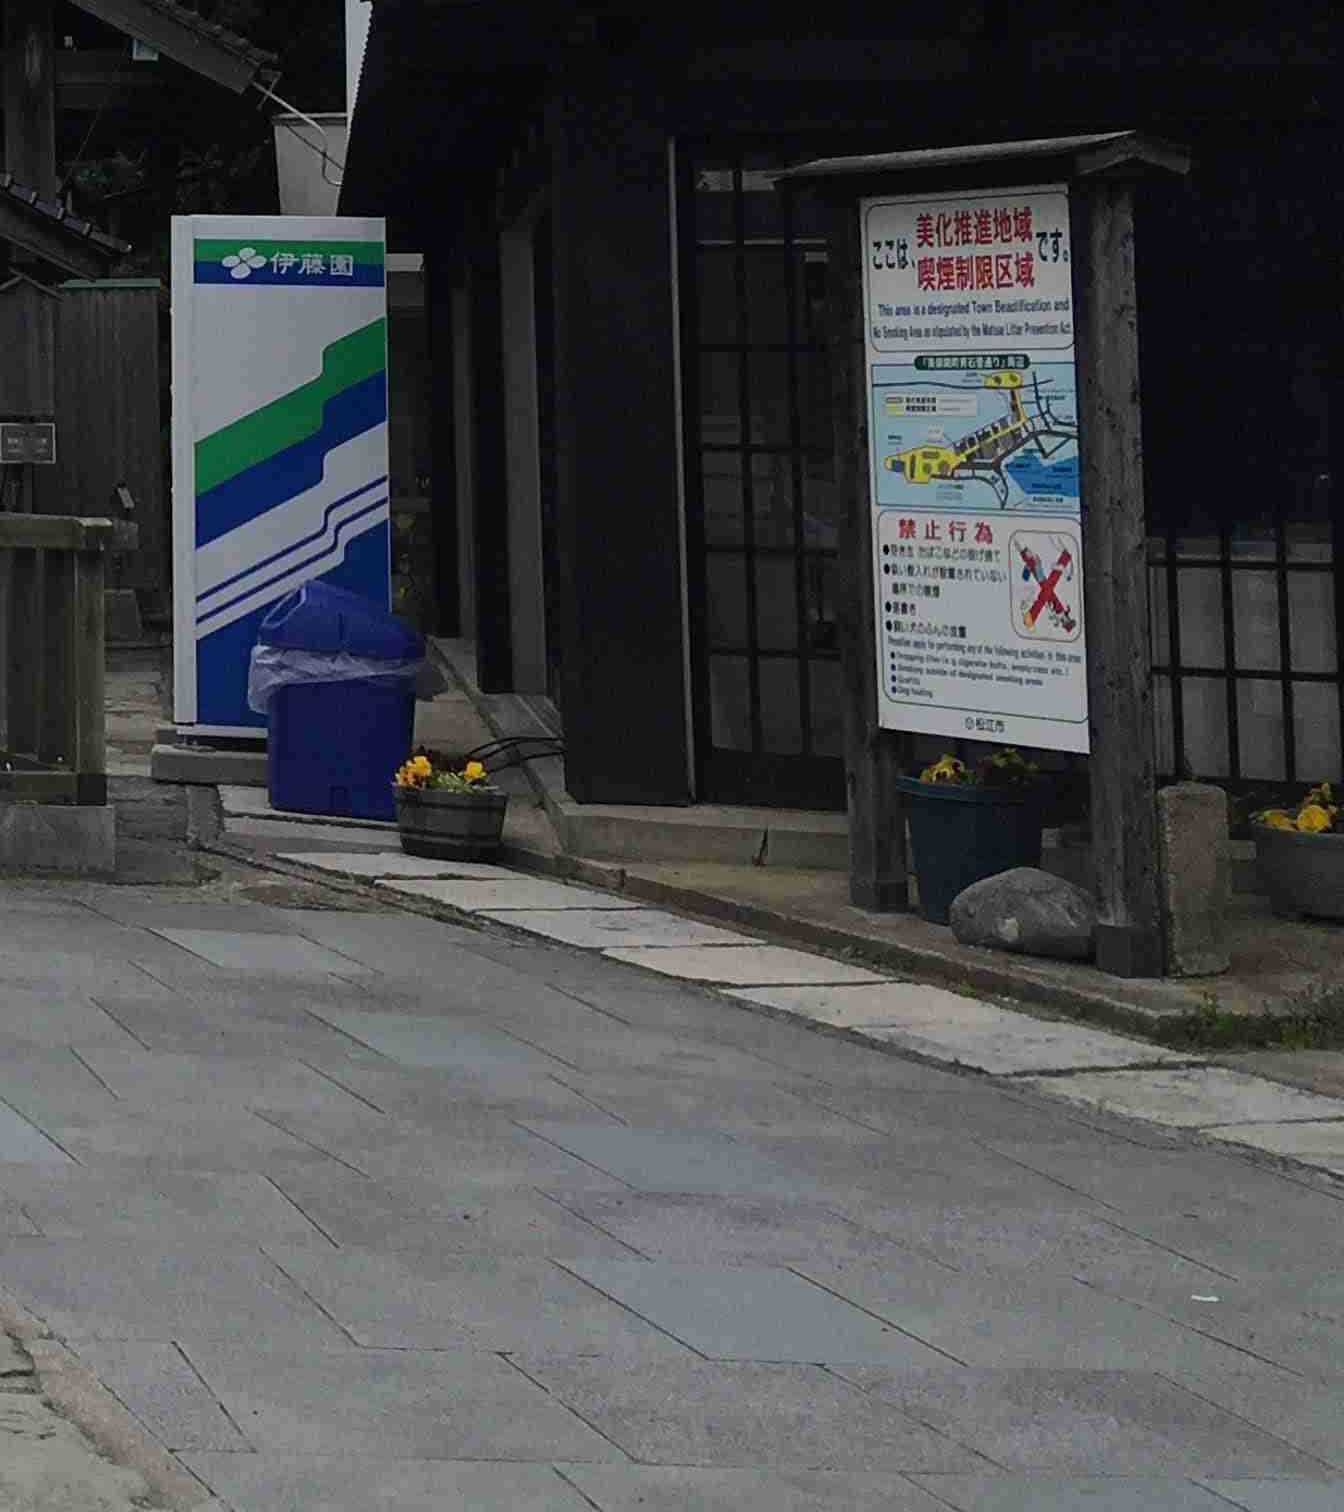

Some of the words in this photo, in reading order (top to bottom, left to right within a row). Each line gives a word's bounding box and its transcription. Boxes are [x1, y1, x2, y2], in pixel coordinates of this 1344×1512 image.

[916, 206, 1033, 248] 美化推進地域
[270, 252, 353, 277] 伊藤園
[917, 252, 1035, 291] 喫煙制限区域
[972, 300, 993, 314] Town
[1054, 296, 1069, 311] and
[898, 518, 993, 545] 禁止行為
